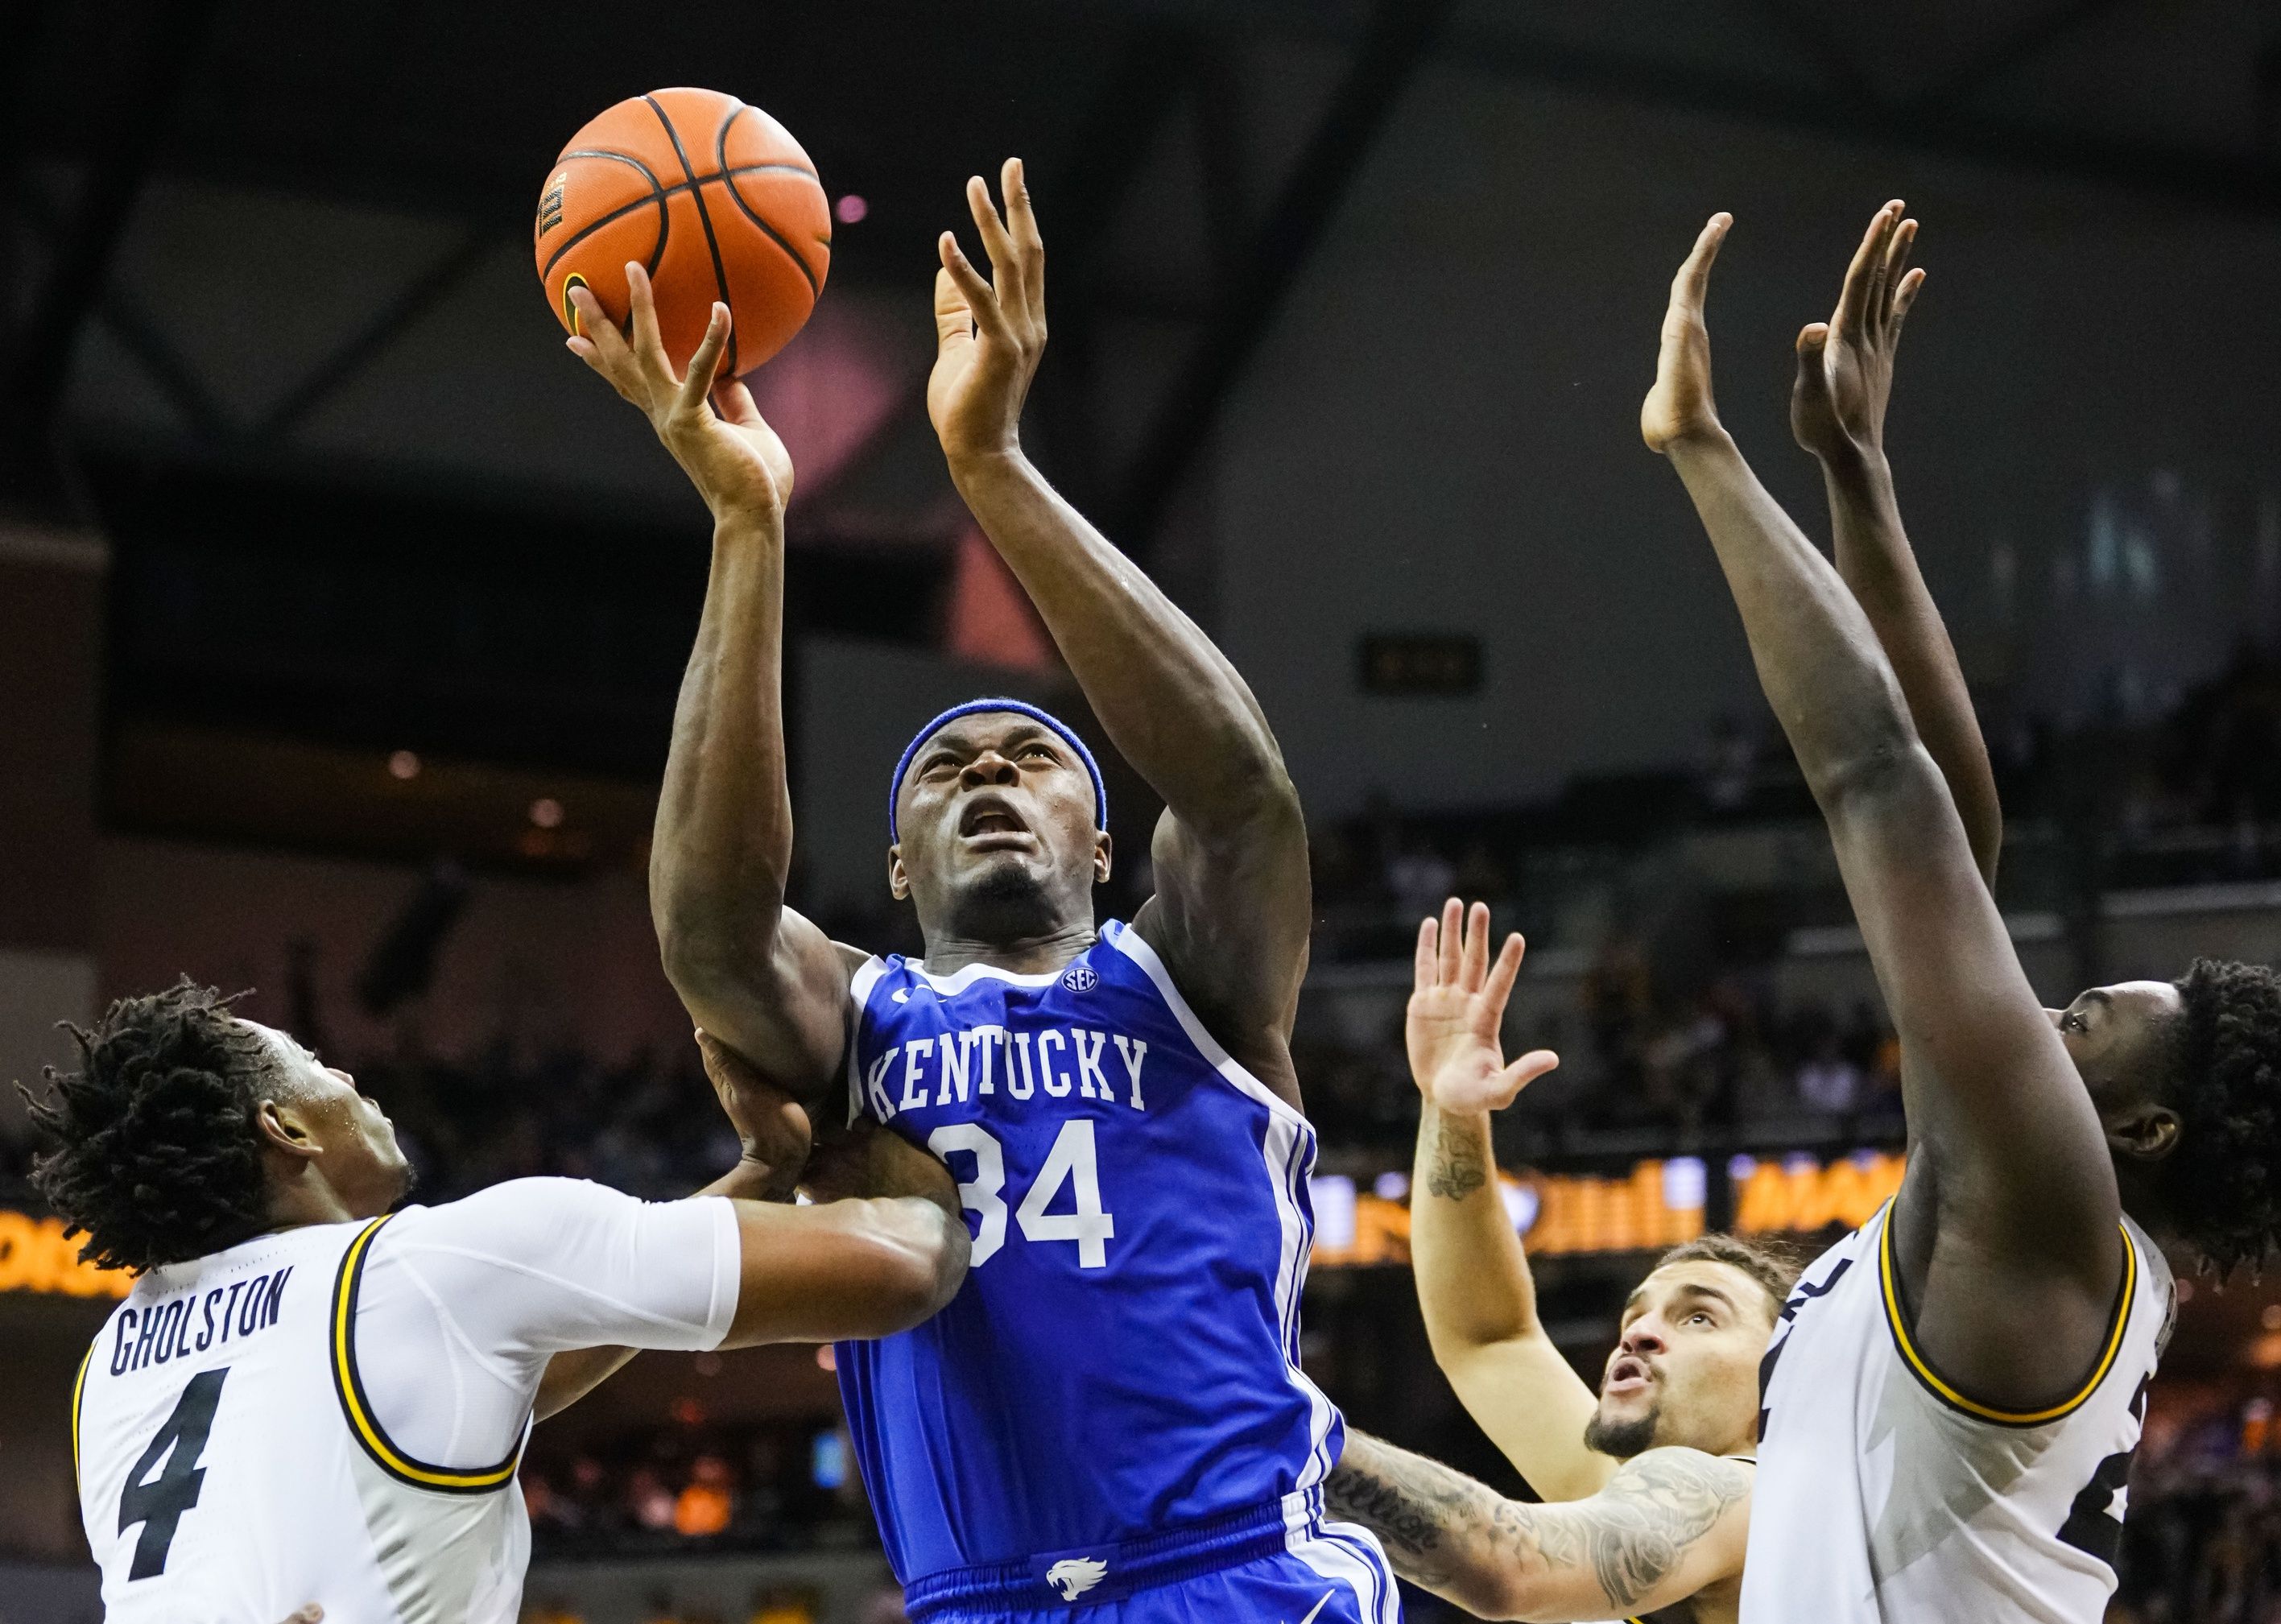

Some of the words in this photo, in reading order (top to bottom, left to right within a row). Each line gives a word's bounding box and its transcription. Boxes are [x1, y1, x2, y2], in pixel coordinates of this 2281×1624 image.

[1065, 969, 1096, 990] SEC
[867, 1024, 1147, 1126] KENTUCKY
[927, 1119, 1114, 1269] 34
[110, 1265, 295, 1376] GHOLSTON
[118, 1366, 231, 1582] 4
